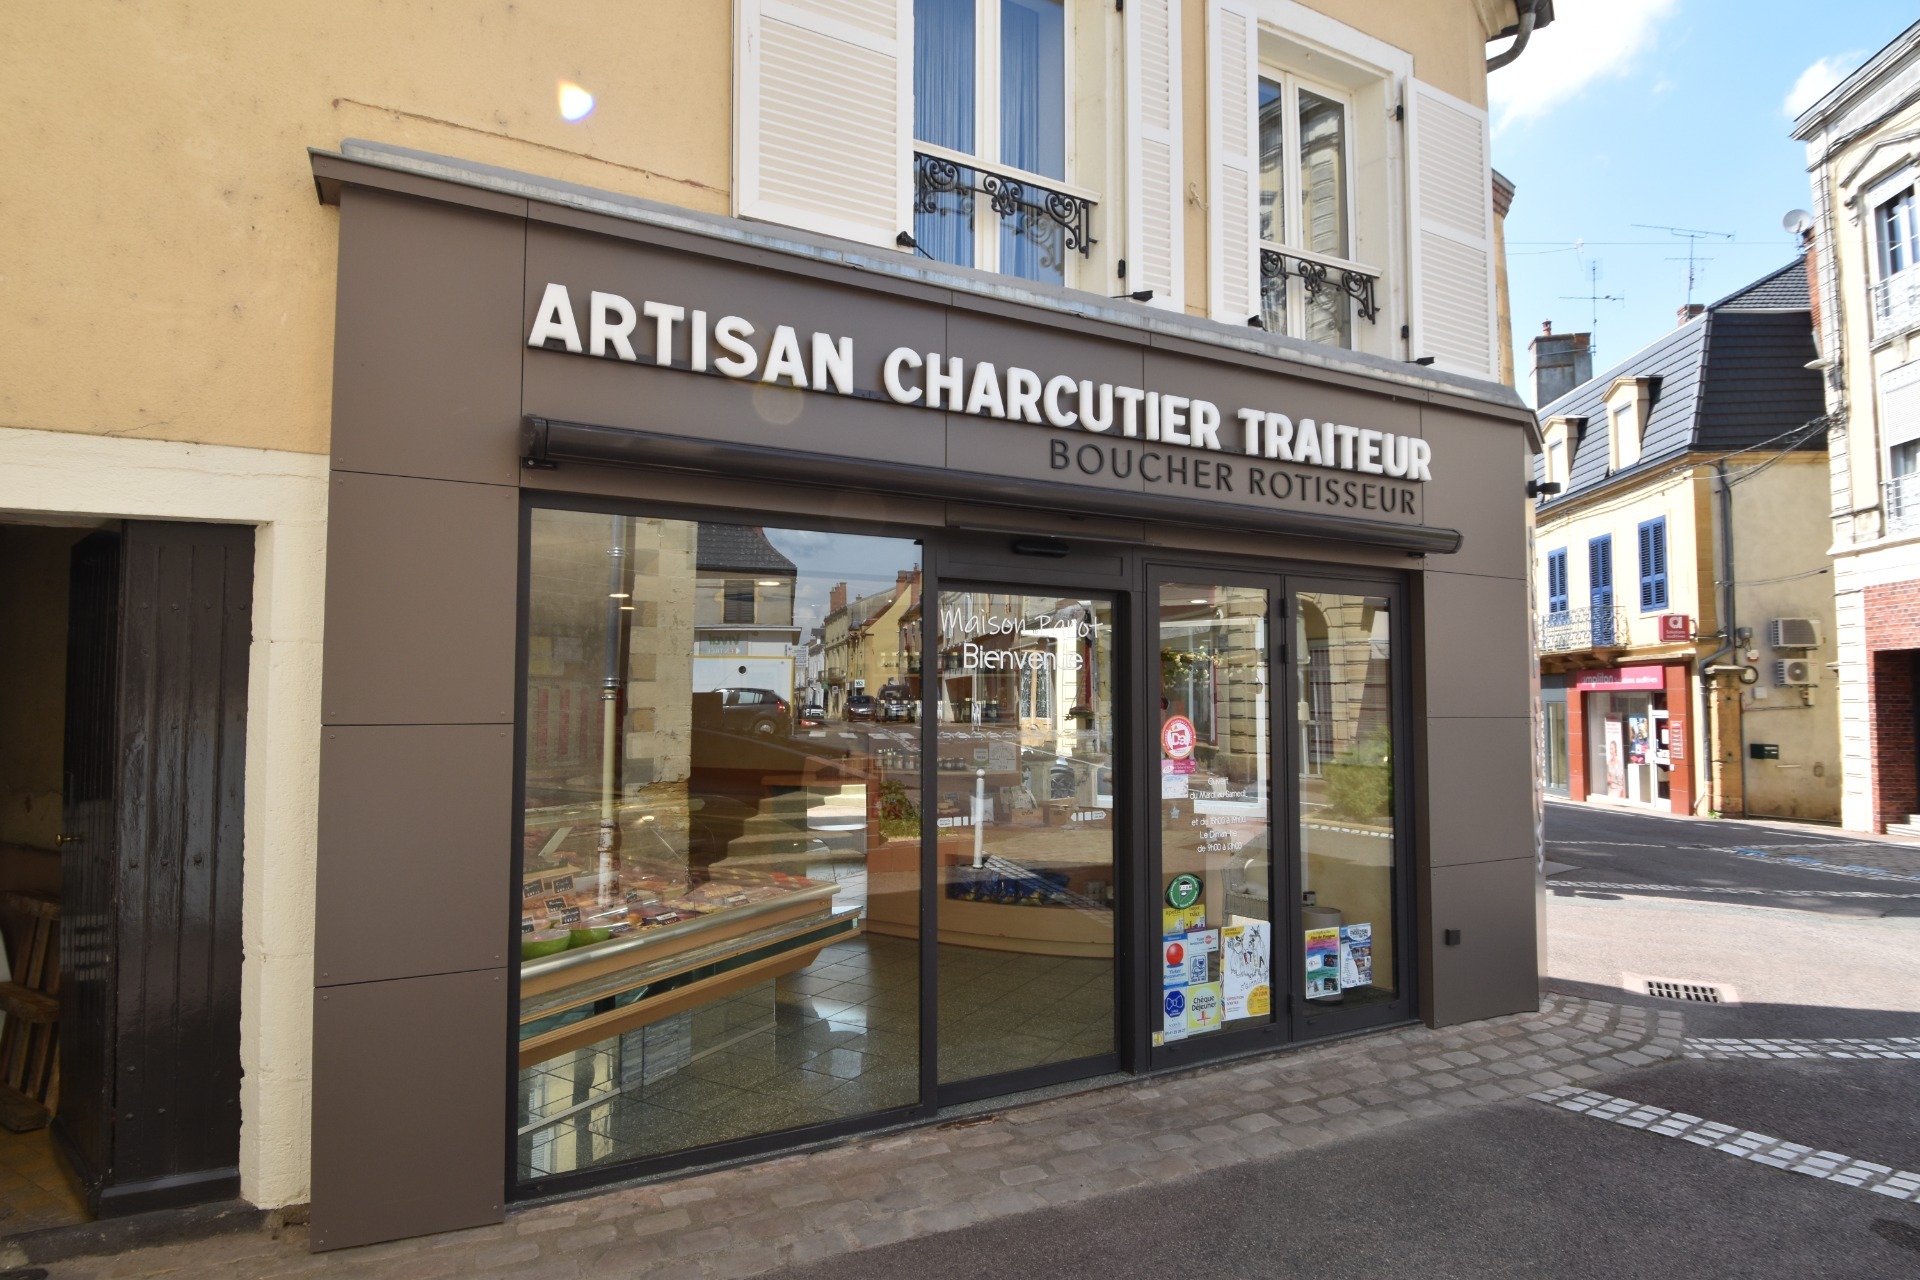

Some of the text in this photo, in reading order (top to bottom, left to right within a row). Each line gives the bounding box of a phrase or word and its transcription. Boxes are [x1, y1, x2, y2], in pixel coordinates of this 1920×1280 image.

[527, 283, 1432, 481] ARTISAN CHARCUTIER TRAITEUR
[1051, 438, 1416, 515] BOUCHER ROTISSEUR
[940, 607, 1026, 635] Maison
[1207, 777, 1229, 786] Ouvert
[1190, 791, 1199, 800] du
[1191, 818, 1199, 827] et
[1200, 830, 1238, 839] Le Dimanhe
[1197, 844, 1206, 853] de
[1193, 995, 1215, 1005] Chèque
